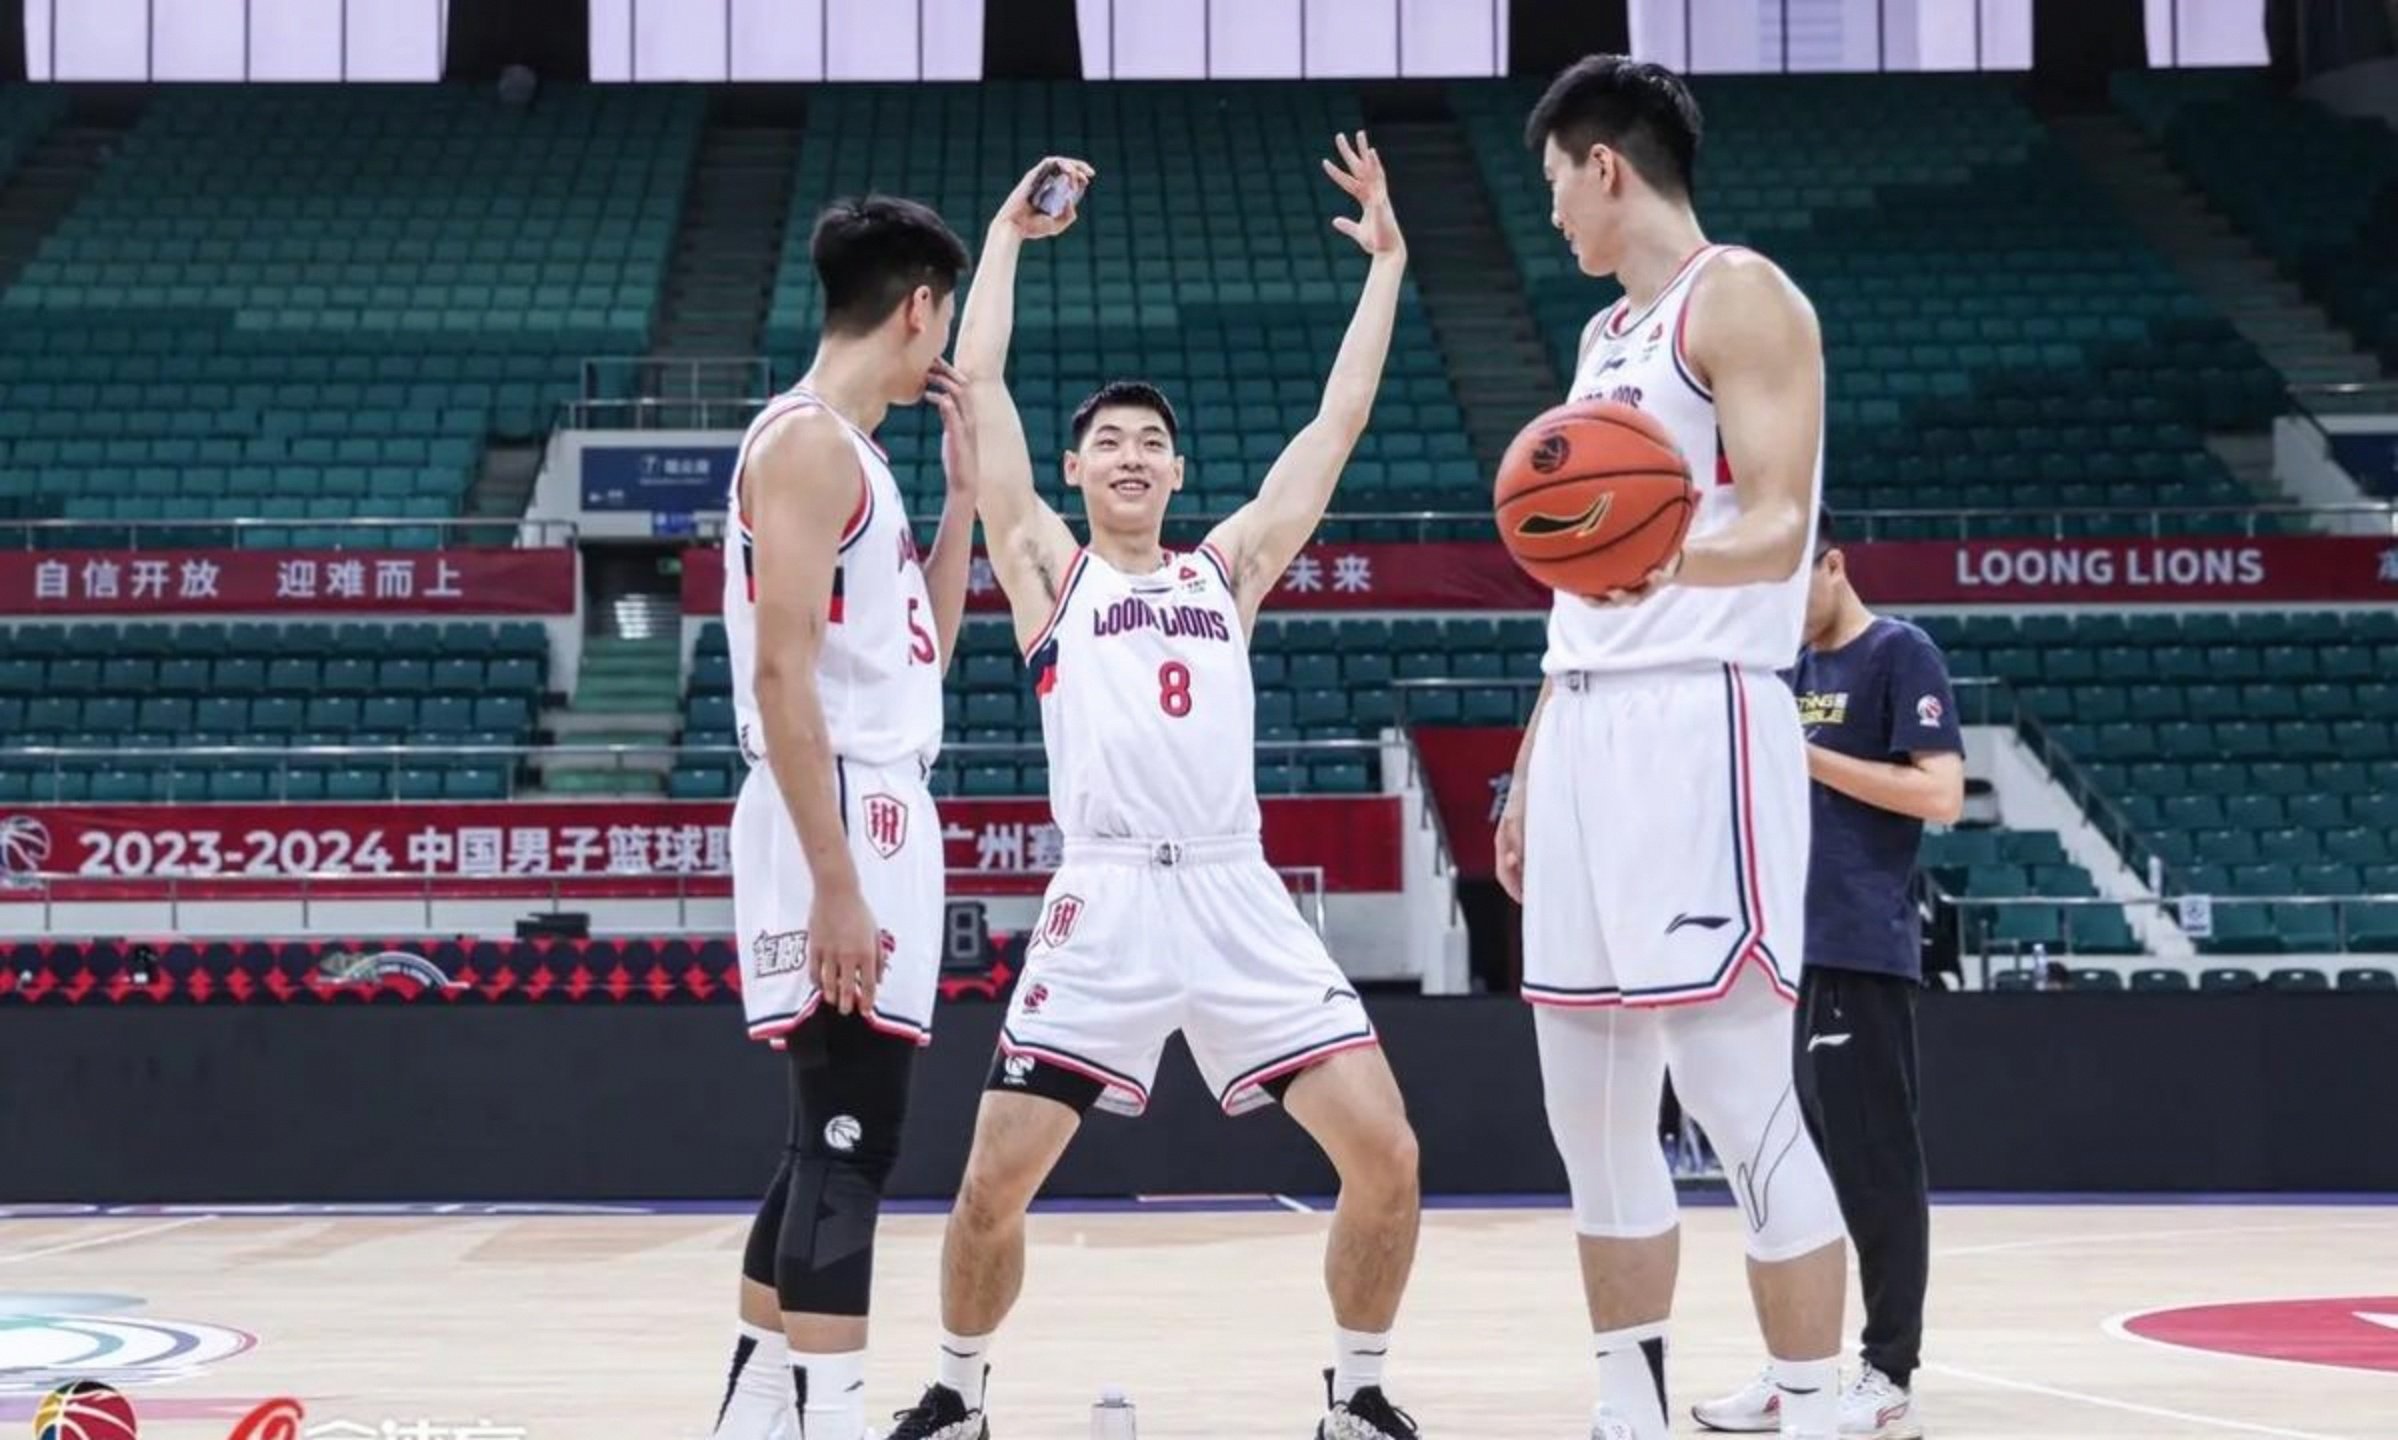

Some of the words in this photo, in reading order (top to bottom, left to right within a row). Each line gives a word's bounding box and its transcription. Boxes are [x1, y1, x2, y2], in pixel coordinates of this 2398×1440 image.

[35, 559, 221, 599] 自信开放
[276, 559, 463, 599] 迎难而上
[1284, 555, 1372, 593] 未来
[1956, 549, 2115, 585] LOONG
[2126, 549, 2265, 585] LIONS
[1093, 597, 1161, 637] LOON
[1159, 604, 1230, 643] LIONS
[1158, 660, 1193, 719] 8
[78, 830, 393, 877] 2023-2024
